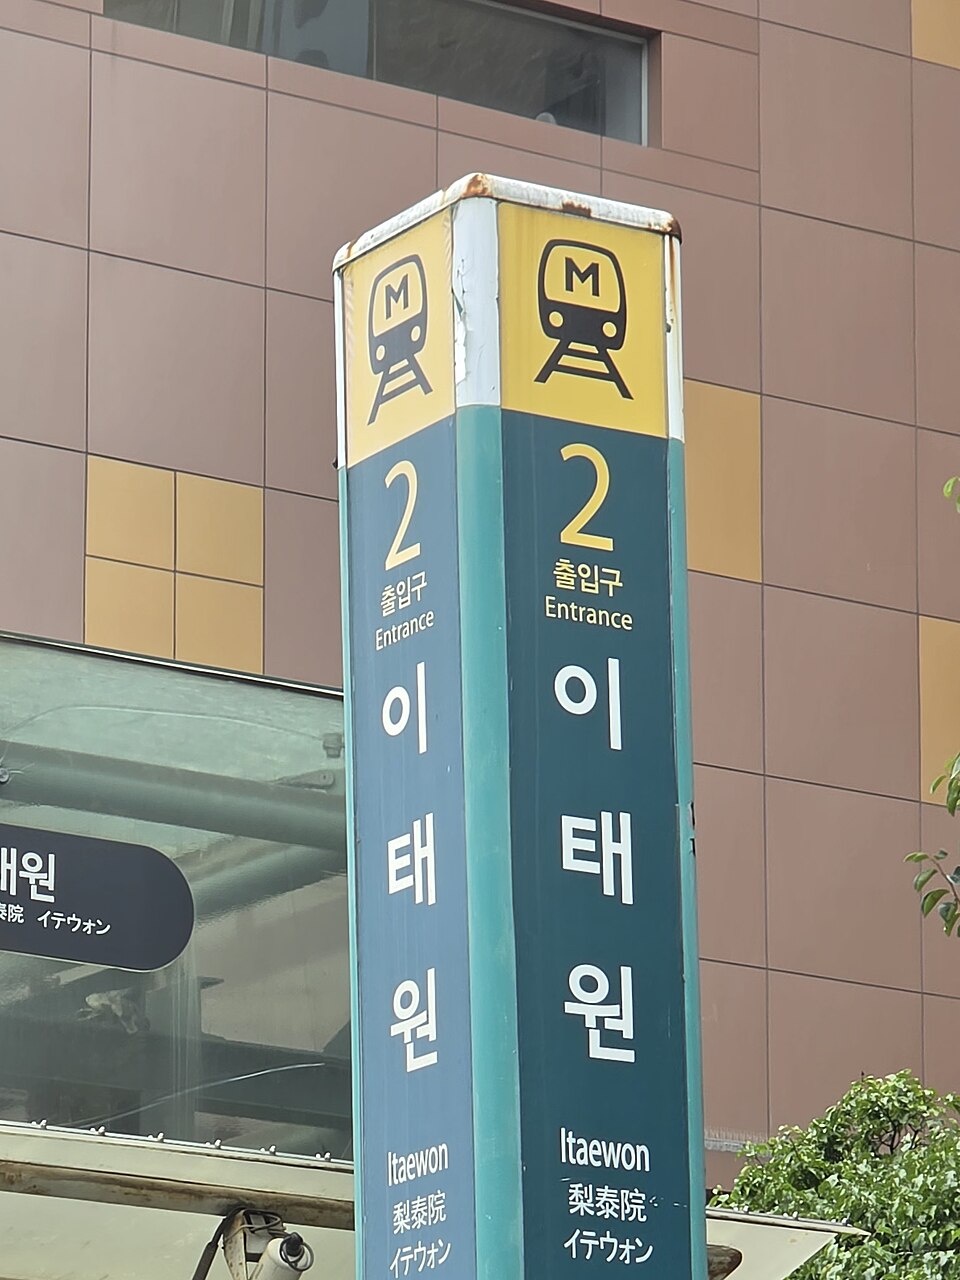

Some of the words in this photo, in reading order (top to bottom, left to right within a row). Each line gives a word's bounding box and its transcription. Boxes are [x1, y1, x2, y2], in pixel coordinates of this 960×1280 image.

[384, 460, 421, 571] 2
[559, 443, 614, 551] 2
[380, 571, 428, 617] 출입구
[552, 557, 624, 597] 출입구
[375, 609, 435, 650] Entrance
[545, 596, 633, 631] Entrance
[382, 661, 438, 1073] 이태원
[554, 657, 635, 1063] 이태원
[37, 911, 111, 936] イテウォン
[388, 1141, 448, 1187] Itaewon
[559, 1127, 650, 1172] Itaewon
[392, 1190, 446, 1235] 梨泰院
[568, 1182, 648, 1223] 梨泰院
[390, 1239, 451, 1279] イテウォン
[563, 1228, 654, 1264] イテウォン
